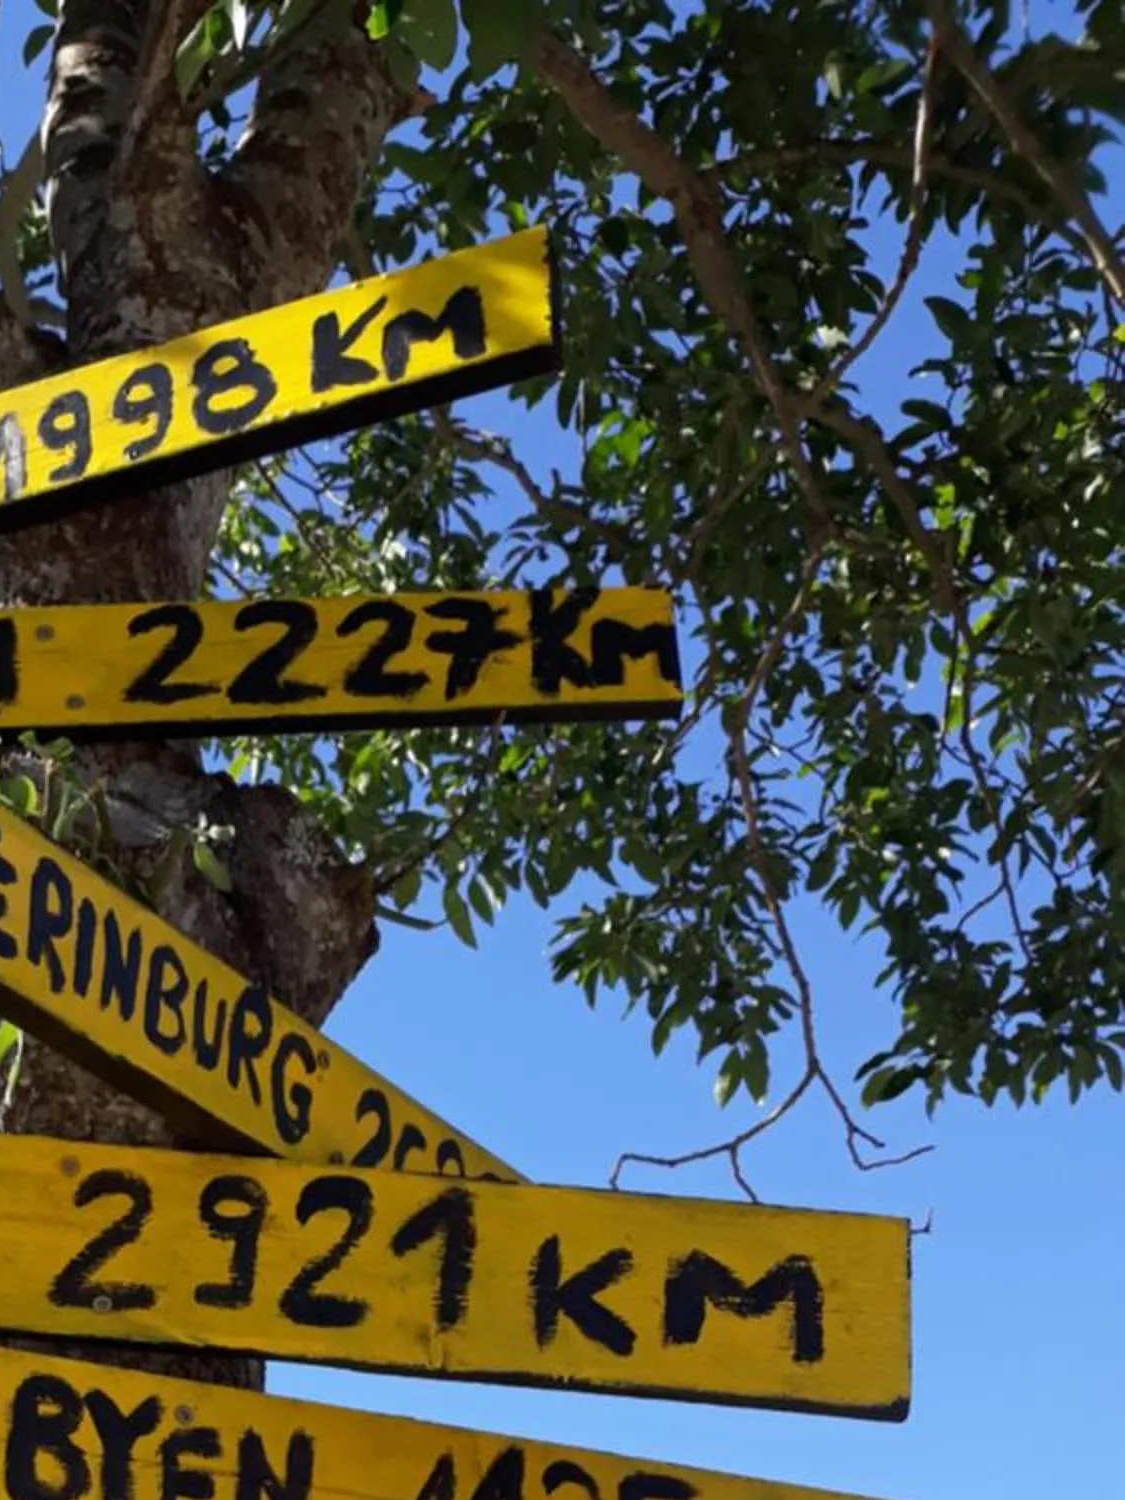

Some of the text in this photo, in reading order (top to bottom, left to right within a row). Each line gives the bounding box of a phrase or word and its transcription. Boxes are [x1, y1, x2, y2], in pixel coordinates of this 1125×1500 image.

[123, 598, 528, 704] 2227
[48, 1168, 479, 1332] 2921
[527, 1233, 824, 1364] KM
